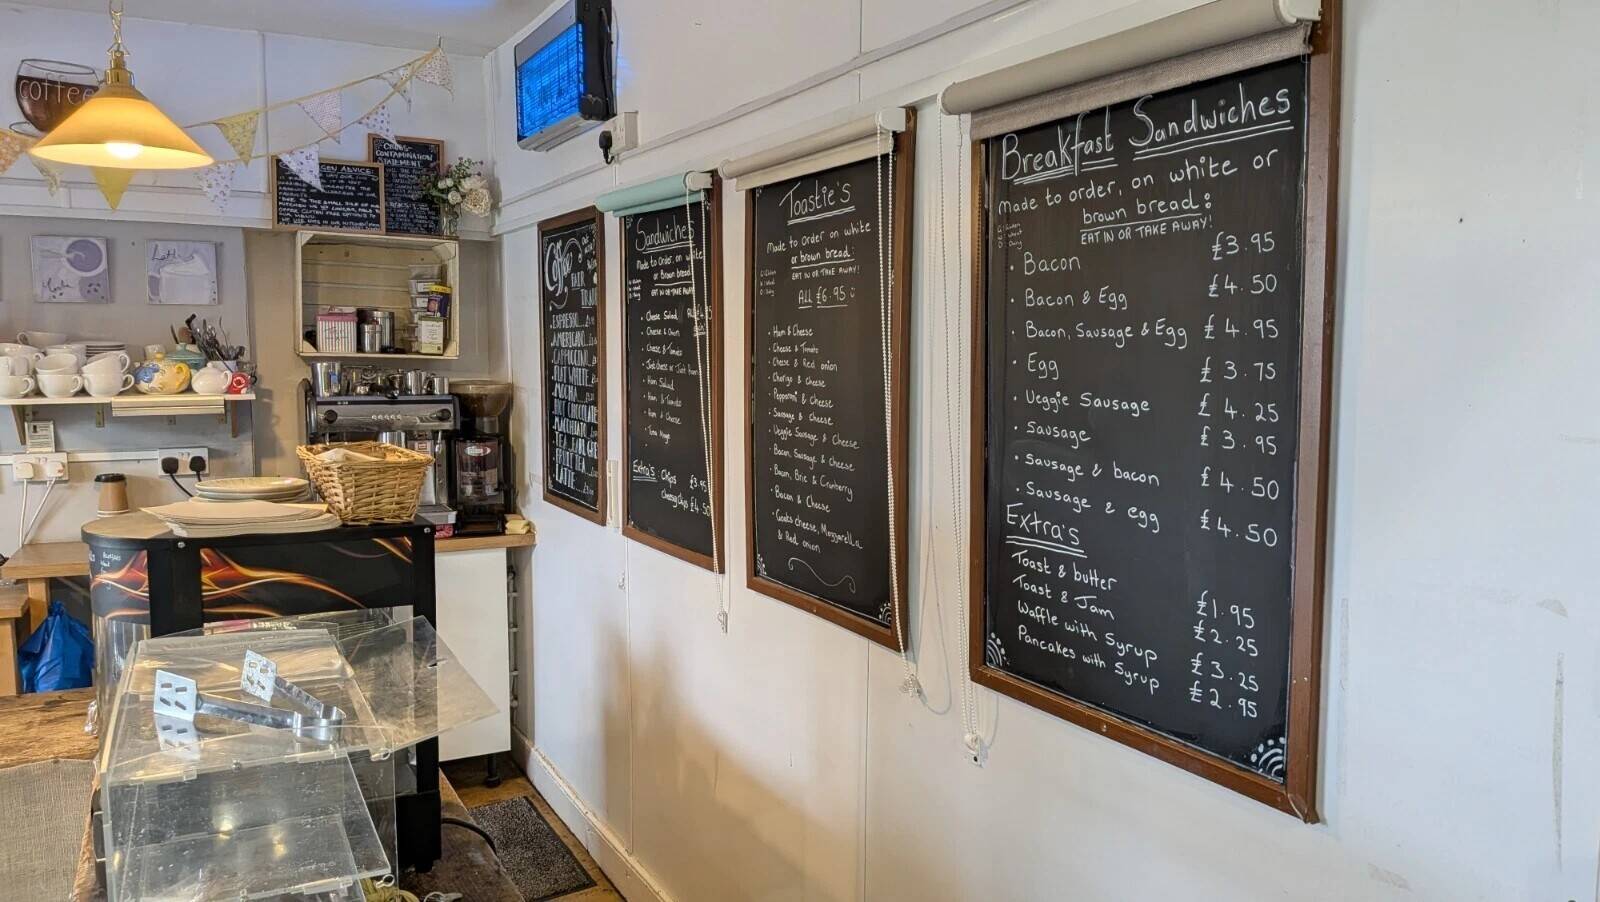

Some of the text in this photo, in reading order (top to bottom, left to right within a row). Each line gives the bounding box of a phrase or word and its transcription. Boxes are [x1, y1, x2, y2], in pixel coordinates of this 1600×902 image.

[19, 74, 95, 104] coffee
[1001, 83, 1290, 180] Breakfast Sandwiches
[999, 149, 1278, 215] Made to order, on white or
[779, 180, 851, 218] Toastie's
[1081, 216, 1213, 245] EAT IN OR TAKE AWAY!
[1083, 208, 1127, 224] brown
[636, 215, 694, 251] Sandwiches
[767, 220, 871, 254] Made to on white
[791, 251, 820, 264] or brown
[1023, 231, 1276, 276] Bacon £3.95
[798, 289, 813, 304] ALL
[1025, 273, 1277, 310] Bacon & Egg £4.50
[773, 324, 813, 337] Ham Cheese
[1025, 314, 1278, 349] Bacon, Sausage & Egg £4.95
[773, 342, 792, 353] Cheese
[803, 358, 815, 369] Red
[821, 361, 837, 372] onion
[1027, 352, 1276, 382] Egg £3.75
[805, 377, 826, 388] Cheese
[773, 407, 795, 423] Sausage
[809, 395, 834, 408] Cheese
[1026, 390, 1279, 423] Veggie Sausage £4.25
[773, 424, 792, 440] Veggie
[795, 427, 819, 447] Sausage
[832, 433, 860, 449] Cheese
[1026, 421, 1277, 455] Sausage £3.95
[794, 448, 817, 470] Sausage
[795, 469, 808, 483] Brie
[820, 475, 853, 502] Cranberry
[1025, 454, 1279, 500] Sausage & bacon £4.50
[775, 484, 794, 501] Bacon
[806, 494, 831, 513] Cheese
[1026, 482, 1277, 547] Sausage & egg £4.50
[776, 509, 793, 523] Goats
[1006, 503, 1080, 546] Extra's
[785, 531, 799, 546] Red
[802, 540, 821, 553] onion
[1011, 550, 1117, 590] Toast & butter
[1013, 574, 1255, 629] Toast & Jam £1.95
[1017, 600, 1258, 668] Waffle with Syrup £2.25
[1018, 625, 1259, 695] Pancakes with Syrup £3.25
[1189, 680, 1258, 718] £2.95
